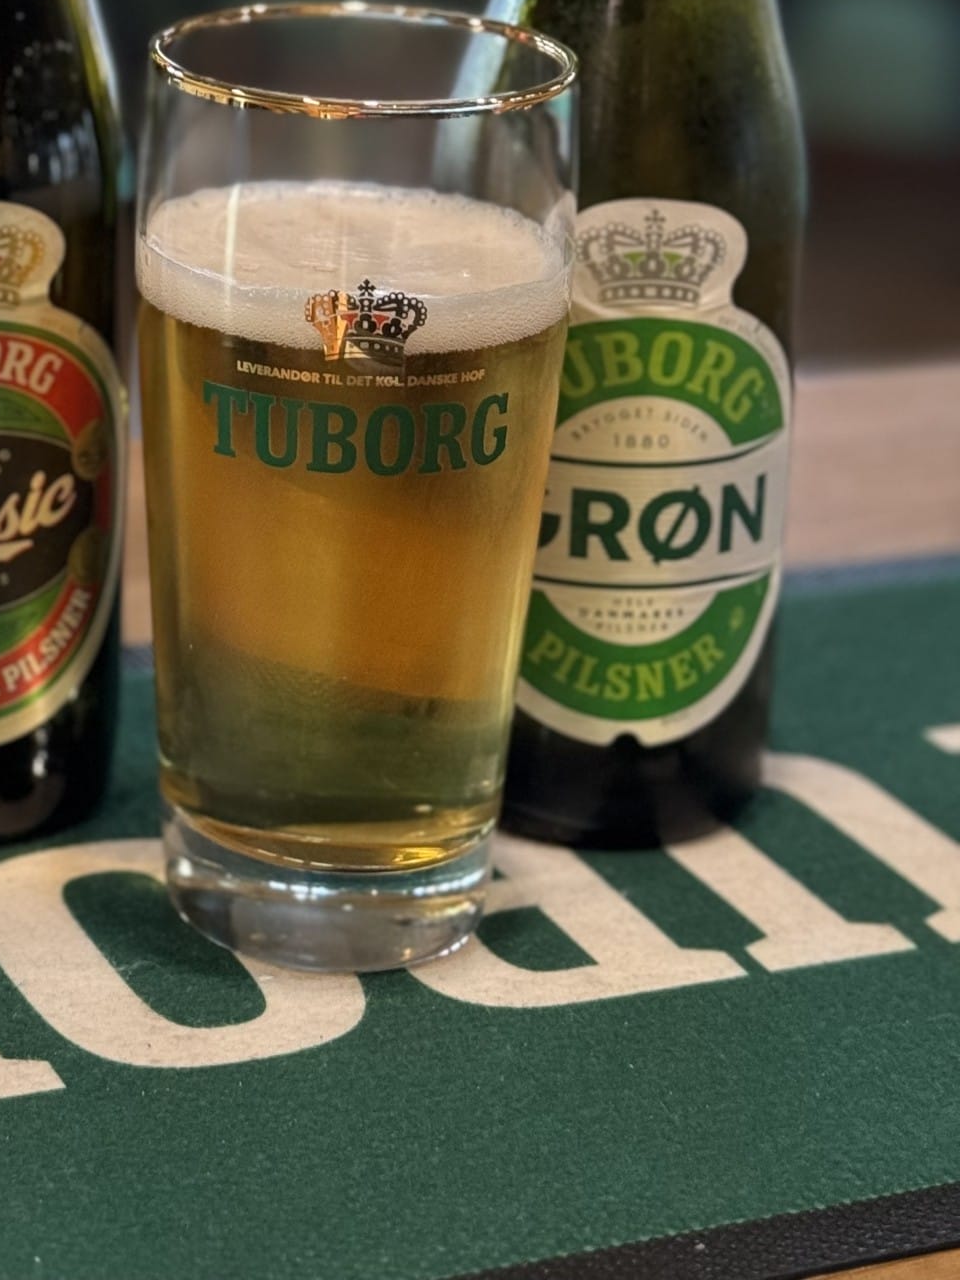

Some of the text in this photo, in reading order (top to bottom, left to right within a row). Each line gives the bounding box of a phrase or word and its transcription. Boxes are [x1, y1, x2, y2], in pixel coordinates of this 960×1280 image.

[236, 359, 321, 384] LEVERANDØR
[322, 373, 343, 386] TIL
[346, 375, 373, 387] DET
[407, 372, 458, 387] DANSKE
[461, 368, 485, 383] HOF
[559, 330, 766, 424] UBORG
[203, 380, 510, 477] TUBORG
[1, 587, 90, 693] PILSNER
[530, 631, 726, 702] PILSNER
